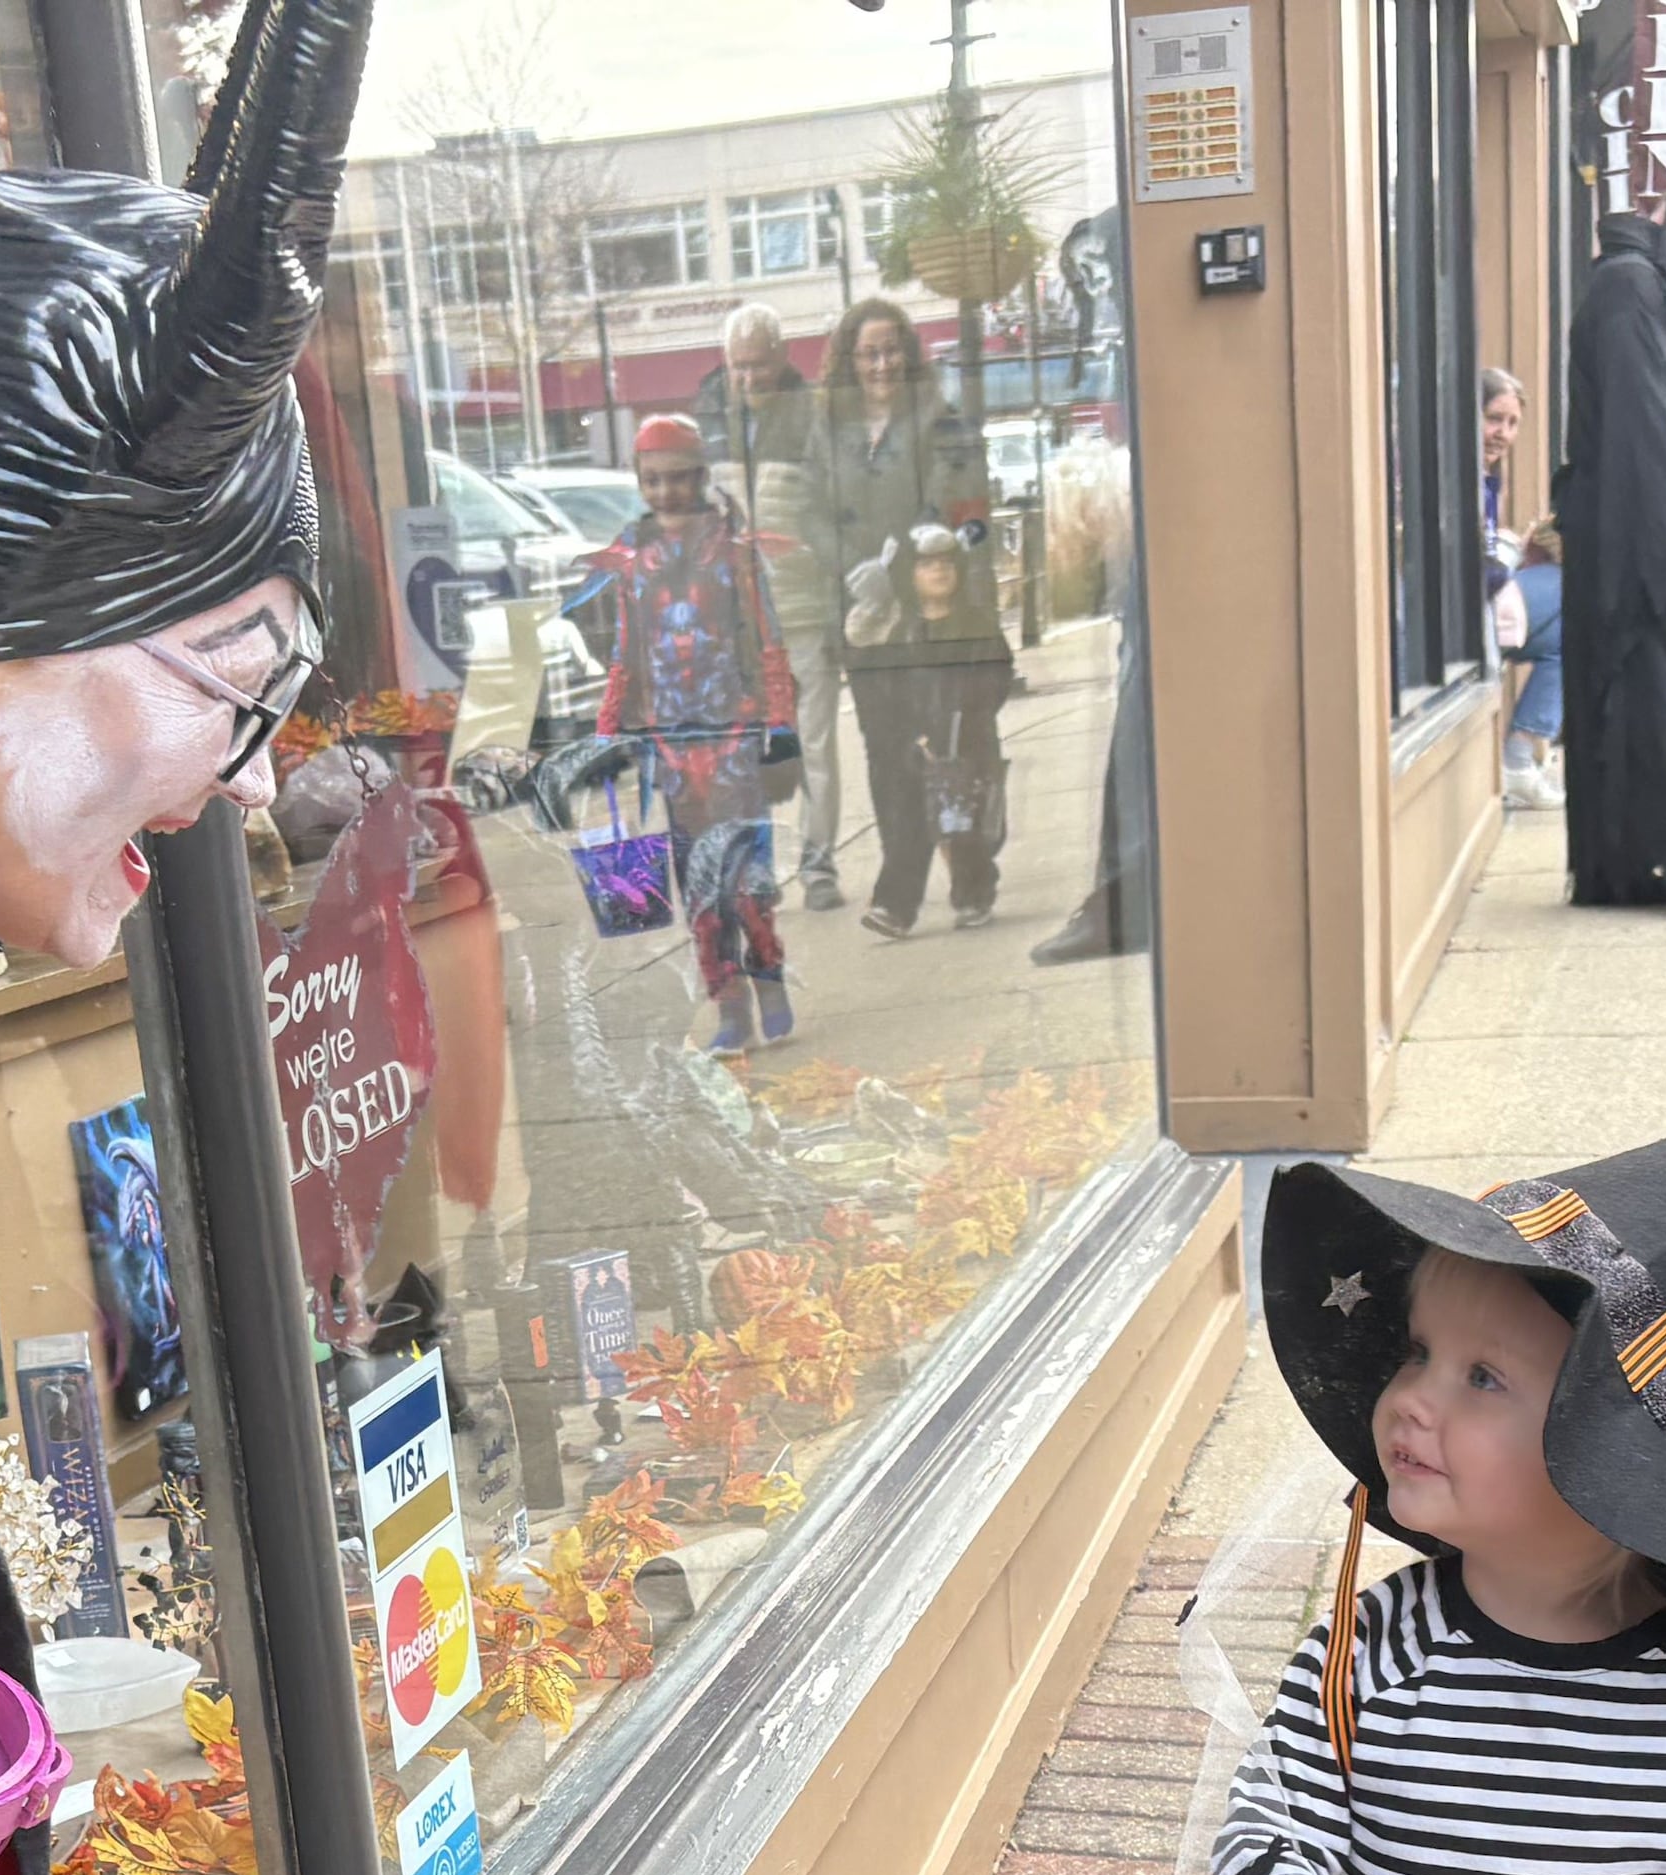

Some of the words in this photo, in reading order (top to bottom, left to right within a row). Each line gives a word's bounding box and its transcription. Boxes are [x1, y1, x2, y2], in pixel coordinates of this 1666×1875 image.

[263, 954, 362, 1039] Sorry
[285, 1026, 357, 1090] we're
[386, 1438, 428, 1504] VISA
[390, 1596, 467, 1687] MasterCard
[415, 1785, 457, 1848] LOREX
[456, 1831, 477, 1862] VIDEO
